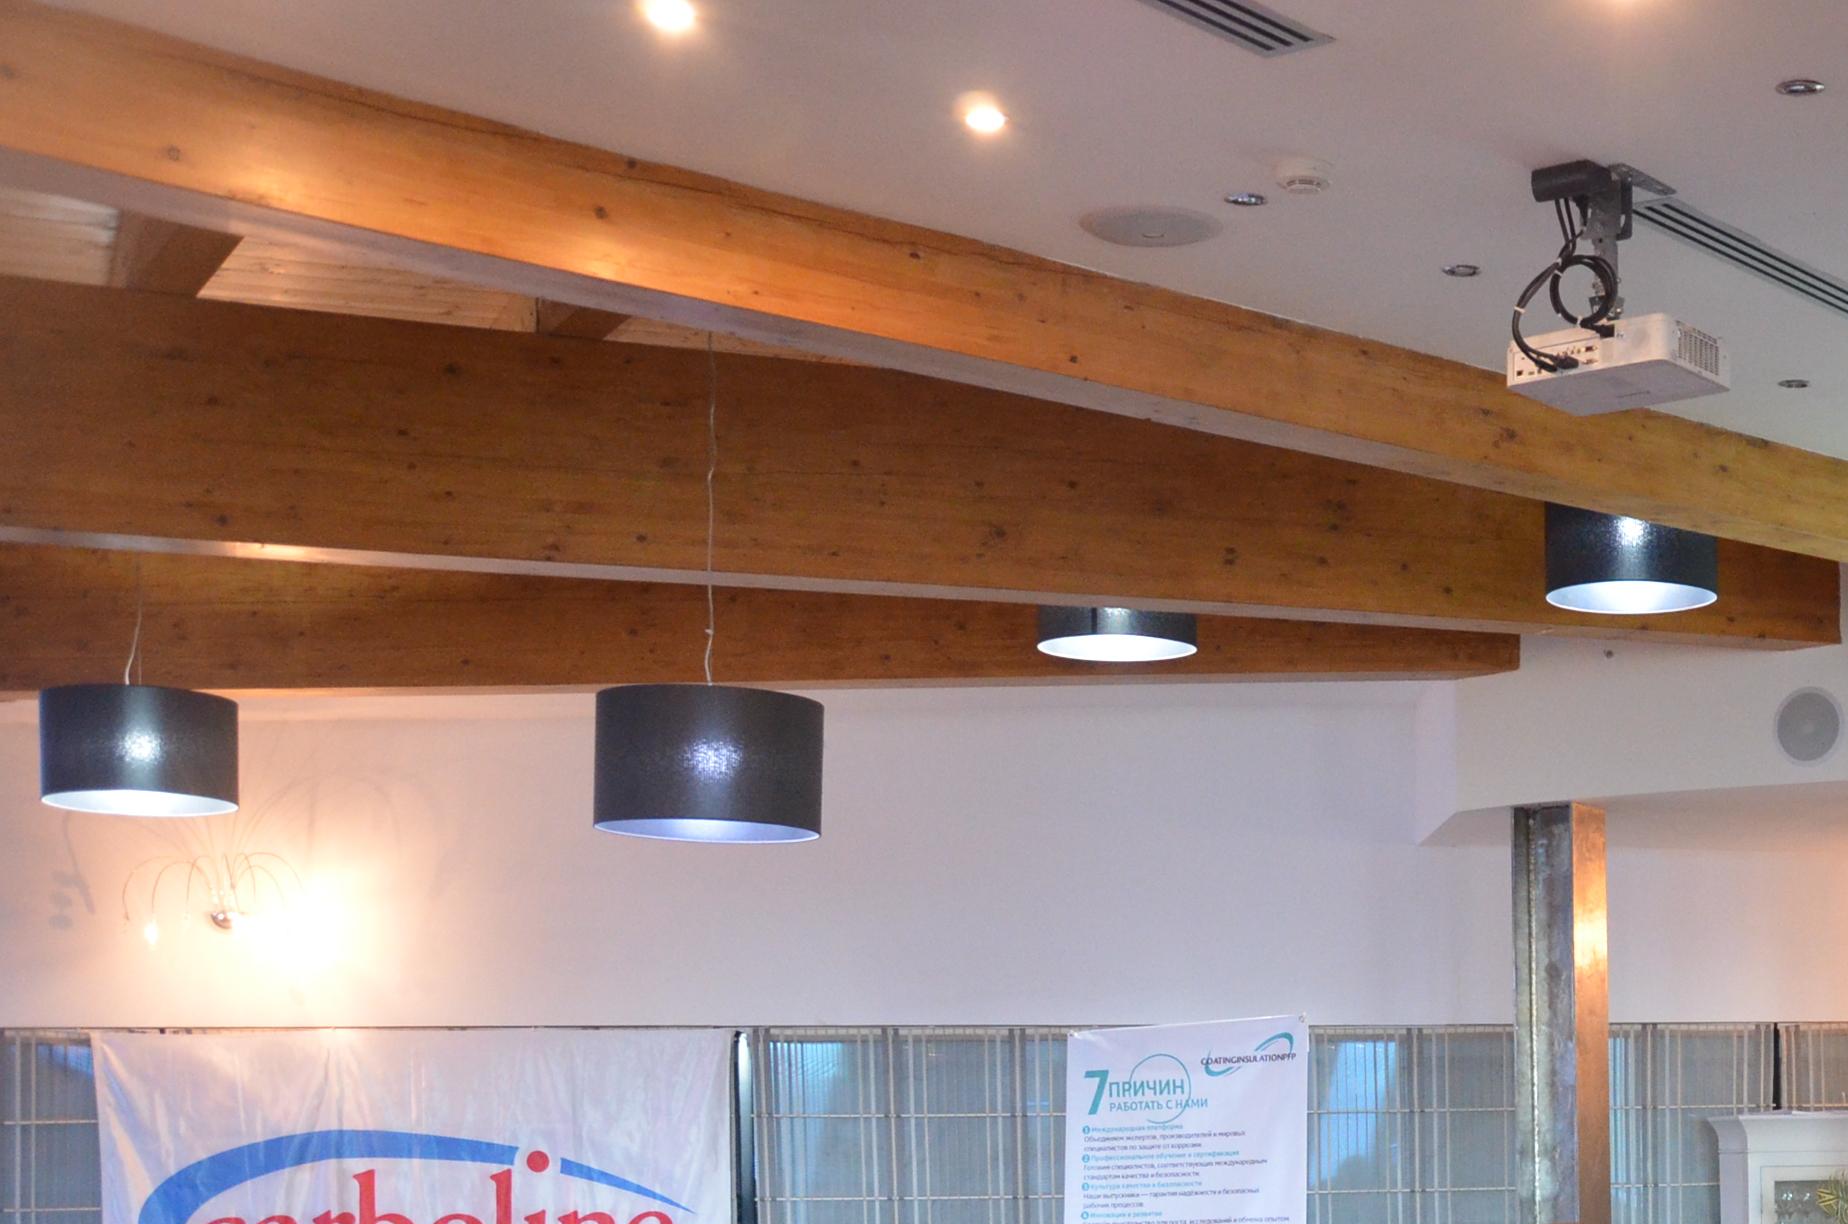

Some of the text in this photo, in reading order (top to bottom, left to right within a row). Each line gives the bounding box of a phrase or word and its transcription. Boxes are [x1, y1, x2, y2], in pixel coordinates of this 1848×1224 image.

[1084, 1069, 1110, 1116] 7
[1109, 1079, 1185, 1098] ПРИЧИН
[1110, 1098, 1208, 1113] РАБОТАТЬ С НАМИ
